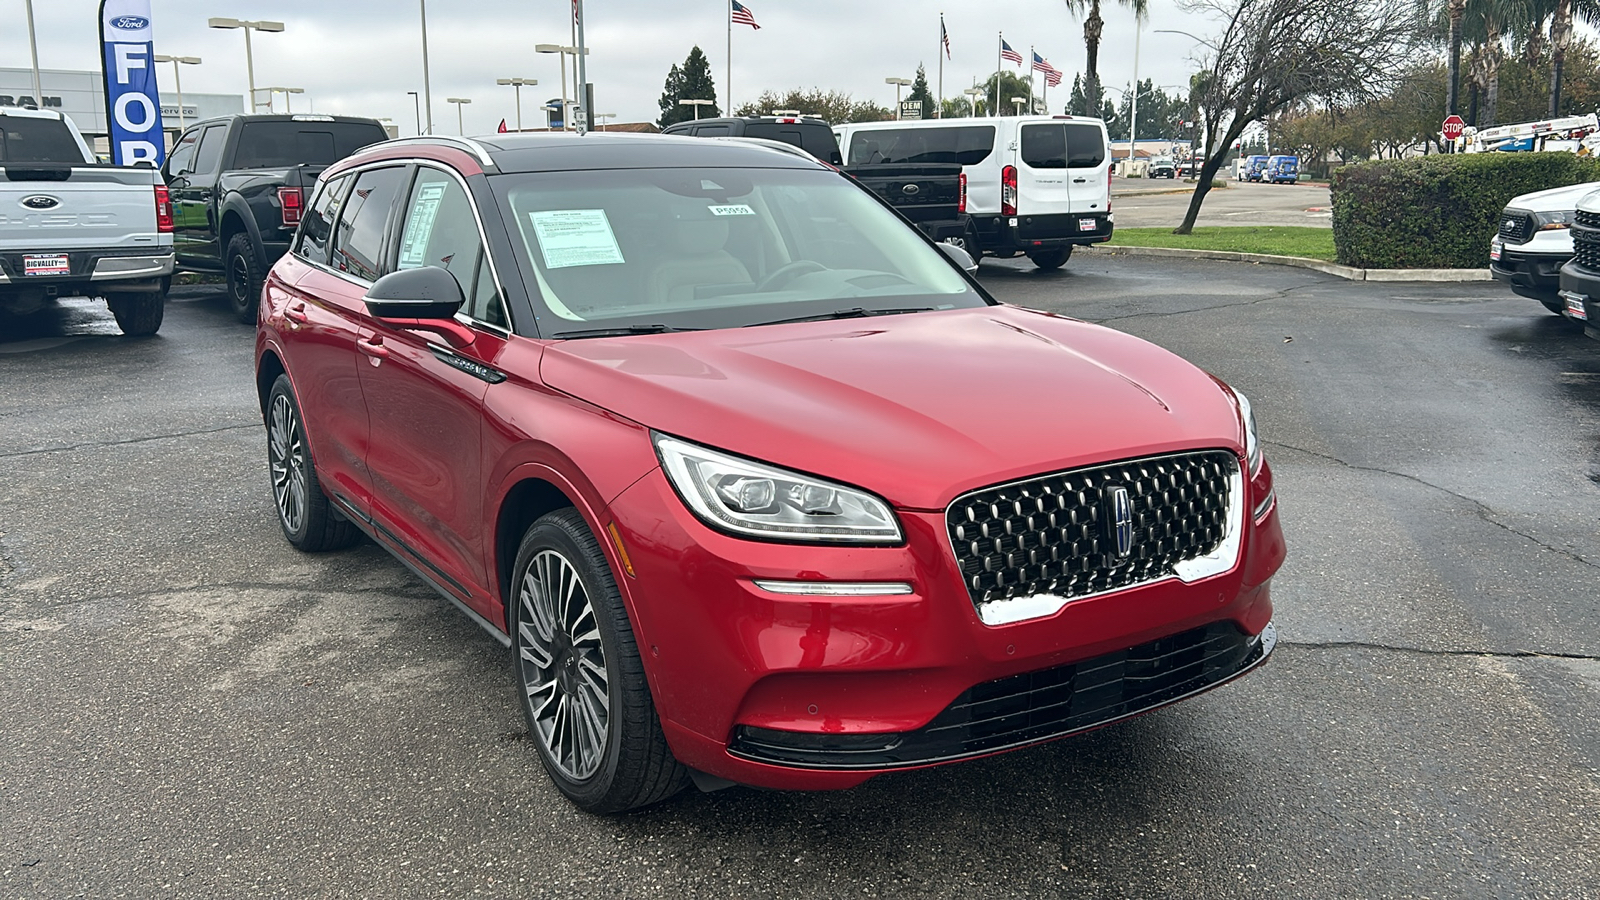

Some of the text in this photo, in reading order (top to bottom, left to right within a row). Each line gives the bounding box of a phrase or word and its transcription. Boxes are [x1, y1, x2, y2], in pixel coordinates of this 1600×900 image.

[117, 17, 144, 29] Ford
[0, 95, 62, 107] RAM
[902, 102, 921, 110] OEM
[1443, 123, 1463, 133] STOP
[716, 207, 749, 215] P5959
